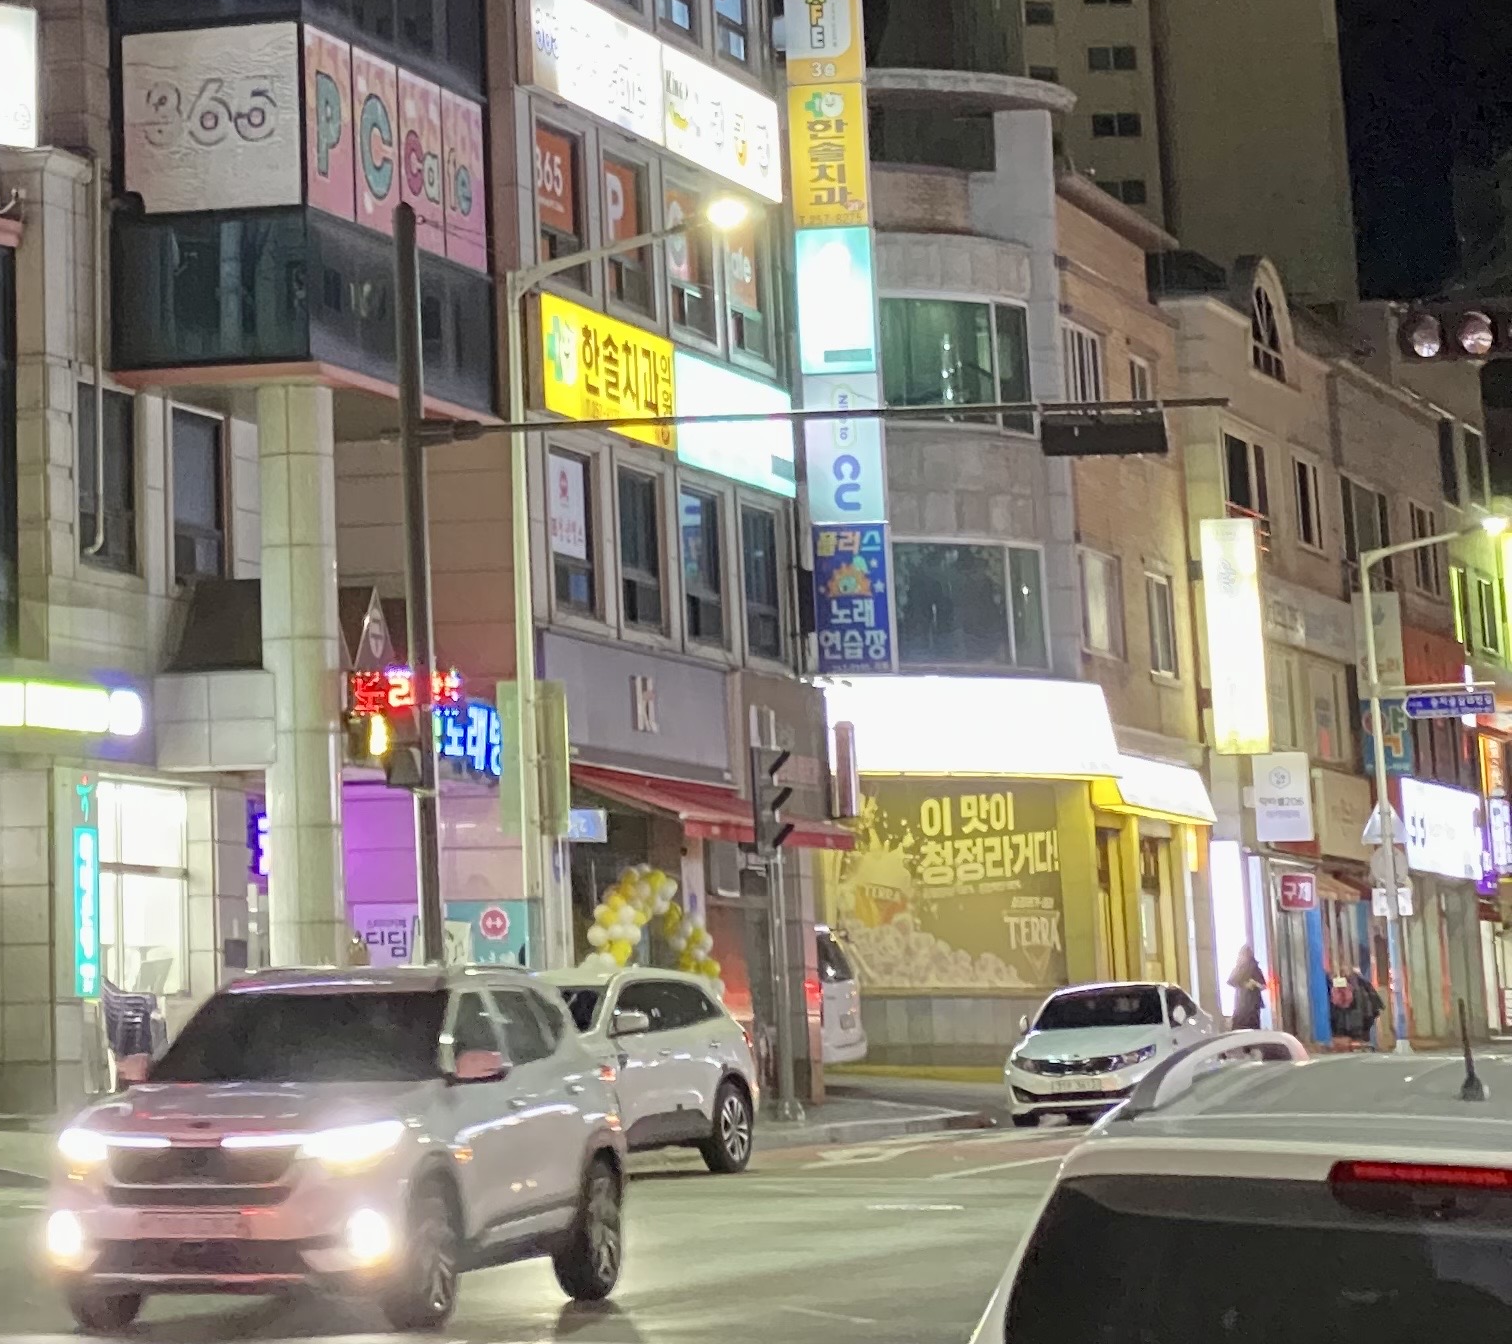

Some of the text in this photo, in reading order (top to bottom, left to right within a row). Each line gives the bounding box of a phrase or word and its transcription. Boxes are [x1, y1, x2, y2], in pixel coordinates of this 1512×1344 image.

[144, 74, 282, 150] 365
[403, 128, 474, 217] Cafe
[806, 118, 849, 206] 한솔치과
[581, 324, 660, 416] 한솔치과
[832, 454, 862, 512] CU
[829, 597, 876, 628] 노래
[818, 628, 888, 661] 연습장
[920, 791, 1015, 837] 이 맛이
[918, 829, 1060, 886] 청정라거다!
[365, 930, 408, 958] 디딤
[1003, 915, 1062, 952] TERRA
